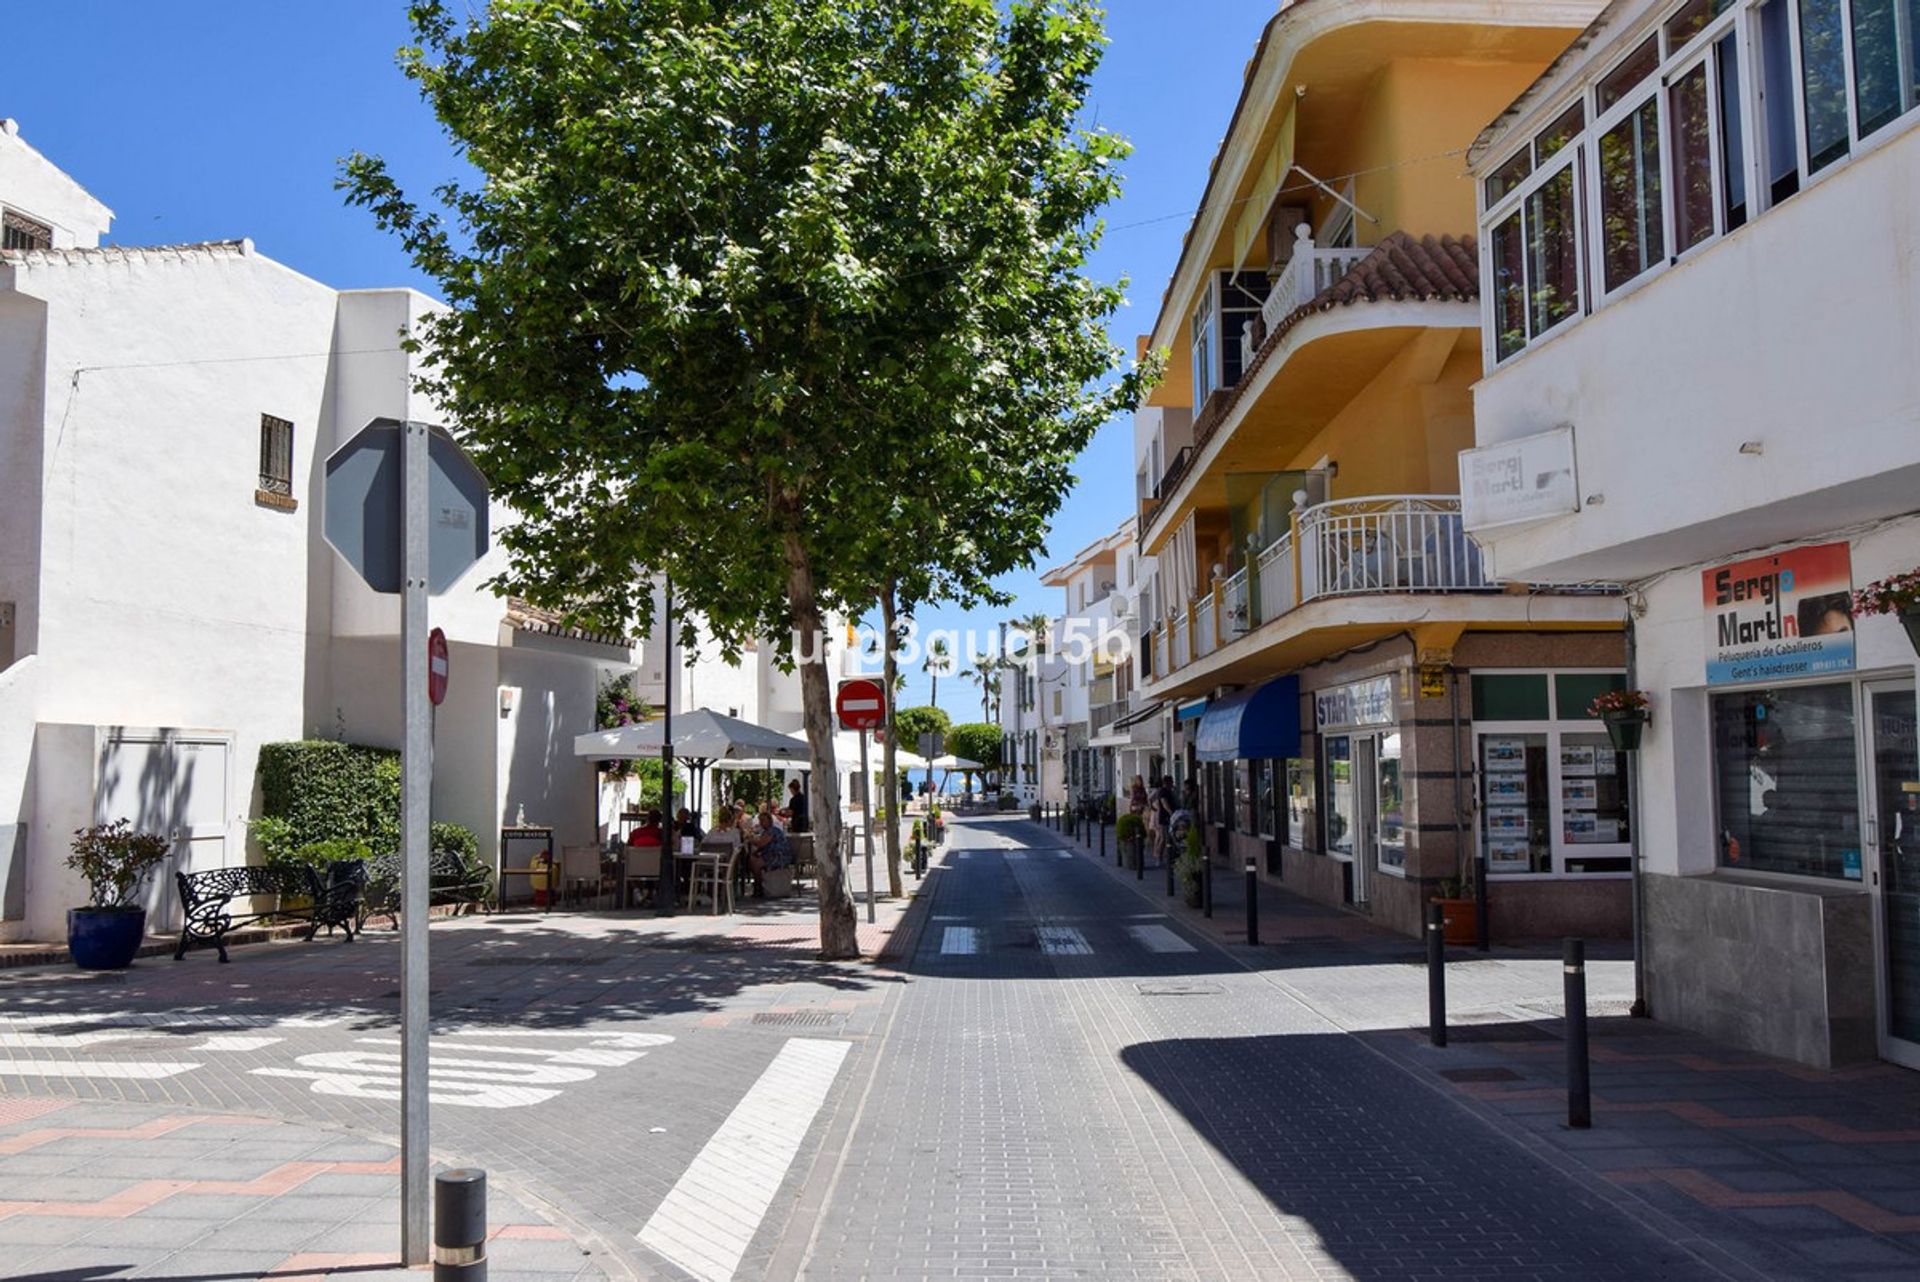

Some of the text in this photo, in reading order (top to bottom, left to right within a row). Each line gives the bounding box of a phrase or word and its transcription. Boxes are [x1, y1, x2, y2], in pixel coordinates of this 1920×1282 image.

[1715, 558, 1795, 606] Sergio
[1717, 611, 1798, 648] Martin
[1763, 646, 1775, 658] de
[1775, 641, 1823, 656] Caballeros
